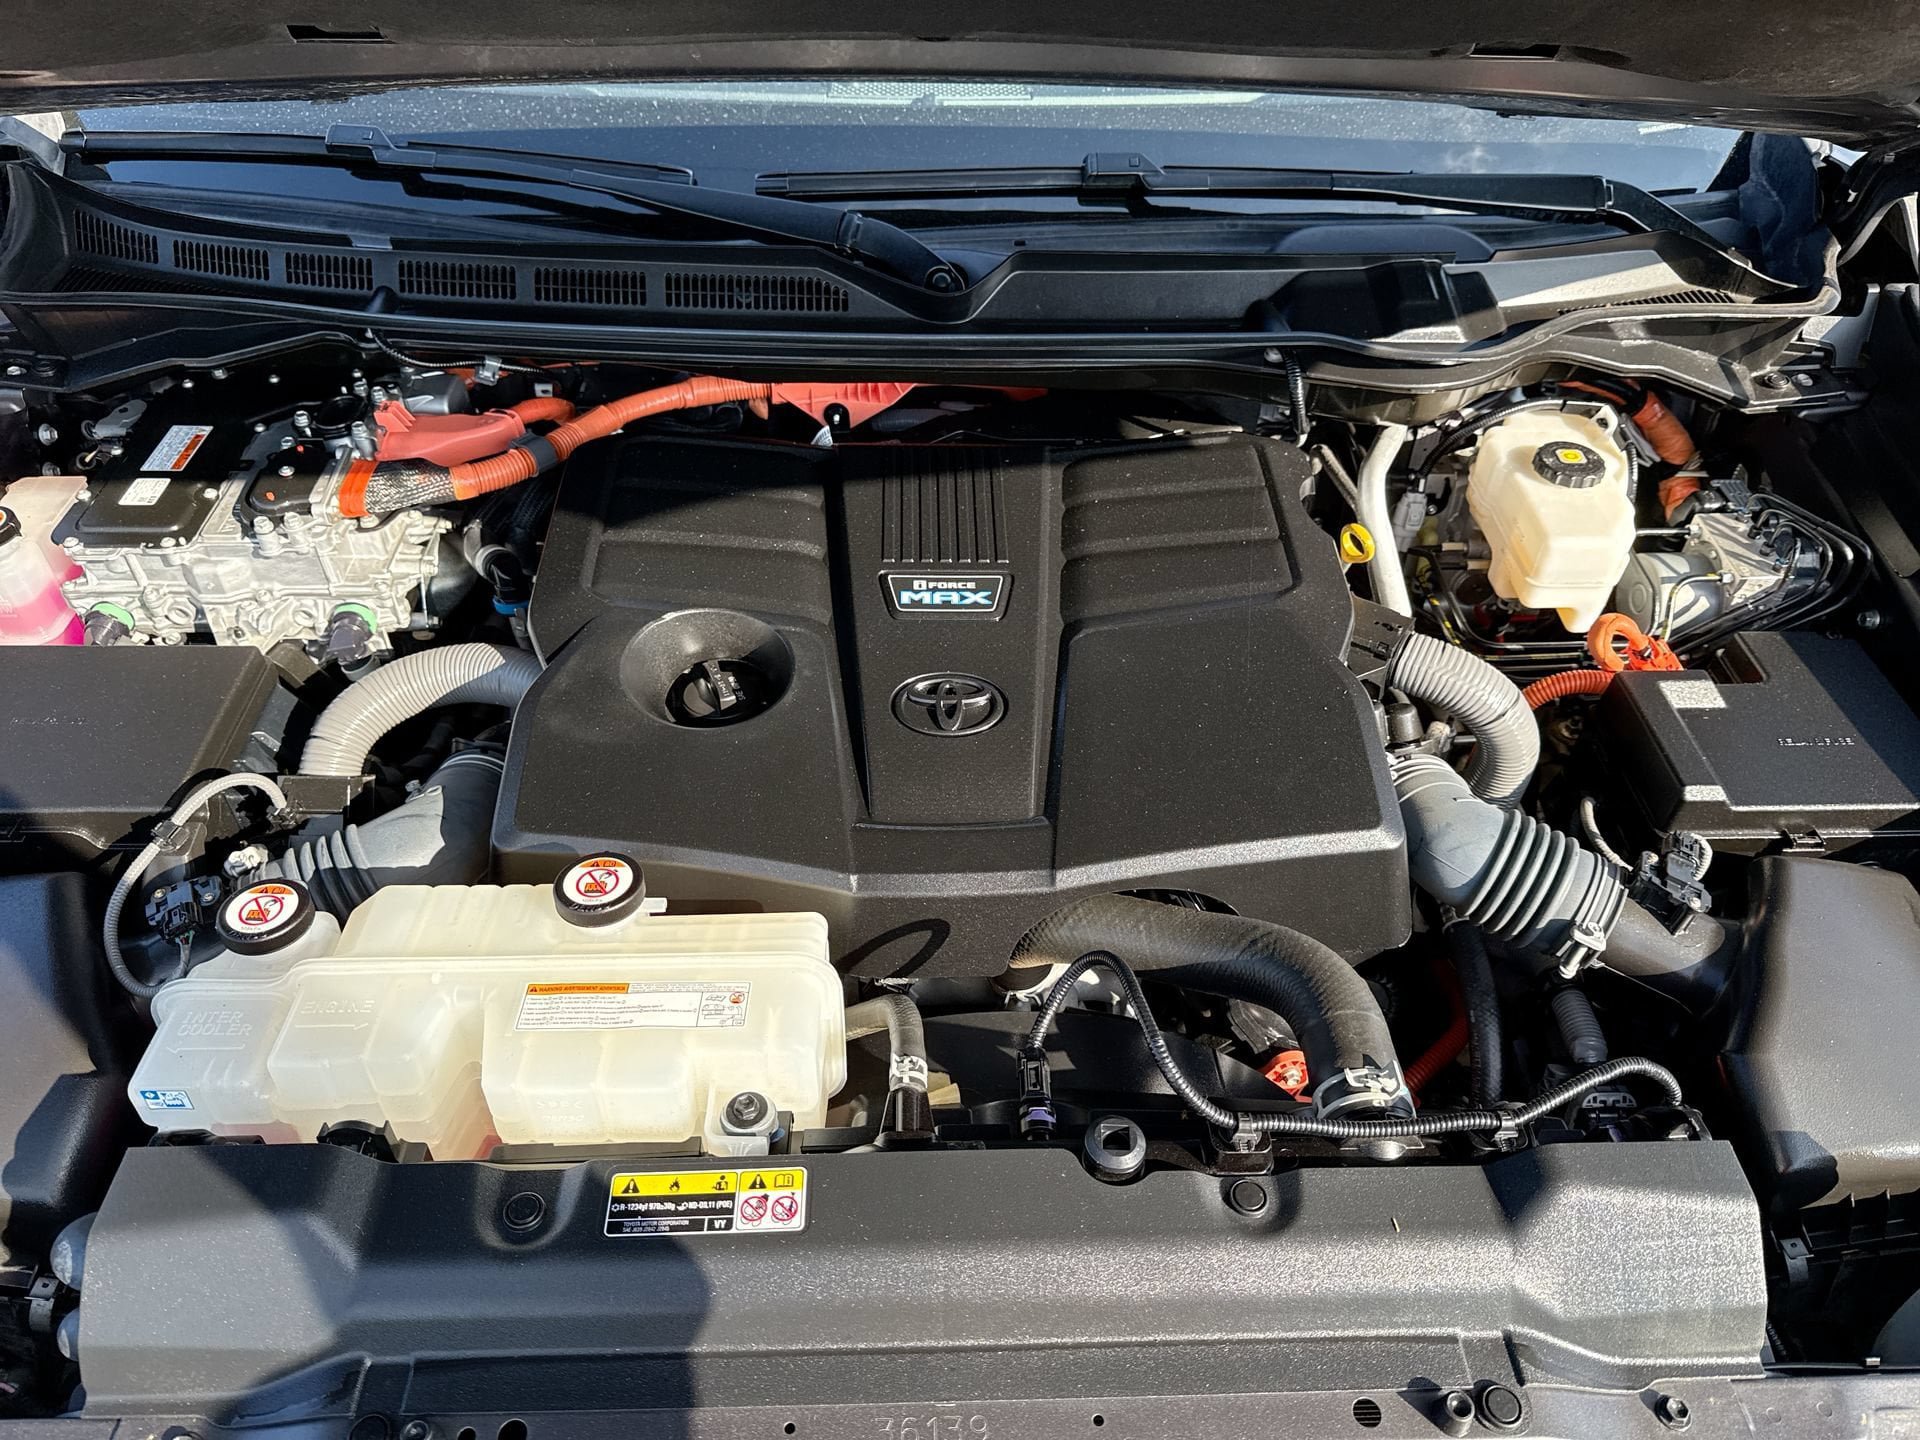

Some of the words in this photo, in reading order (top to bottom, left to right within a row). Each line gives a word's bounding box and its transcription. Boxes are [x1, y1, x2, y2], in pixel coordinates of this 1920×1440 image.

[900, 591, 992, 605] MAX
[182, 1011, 244, 1023] INTER
[177, 1023, 252, 1036] COOLER
[714, 1219, 727, 1229] VY
